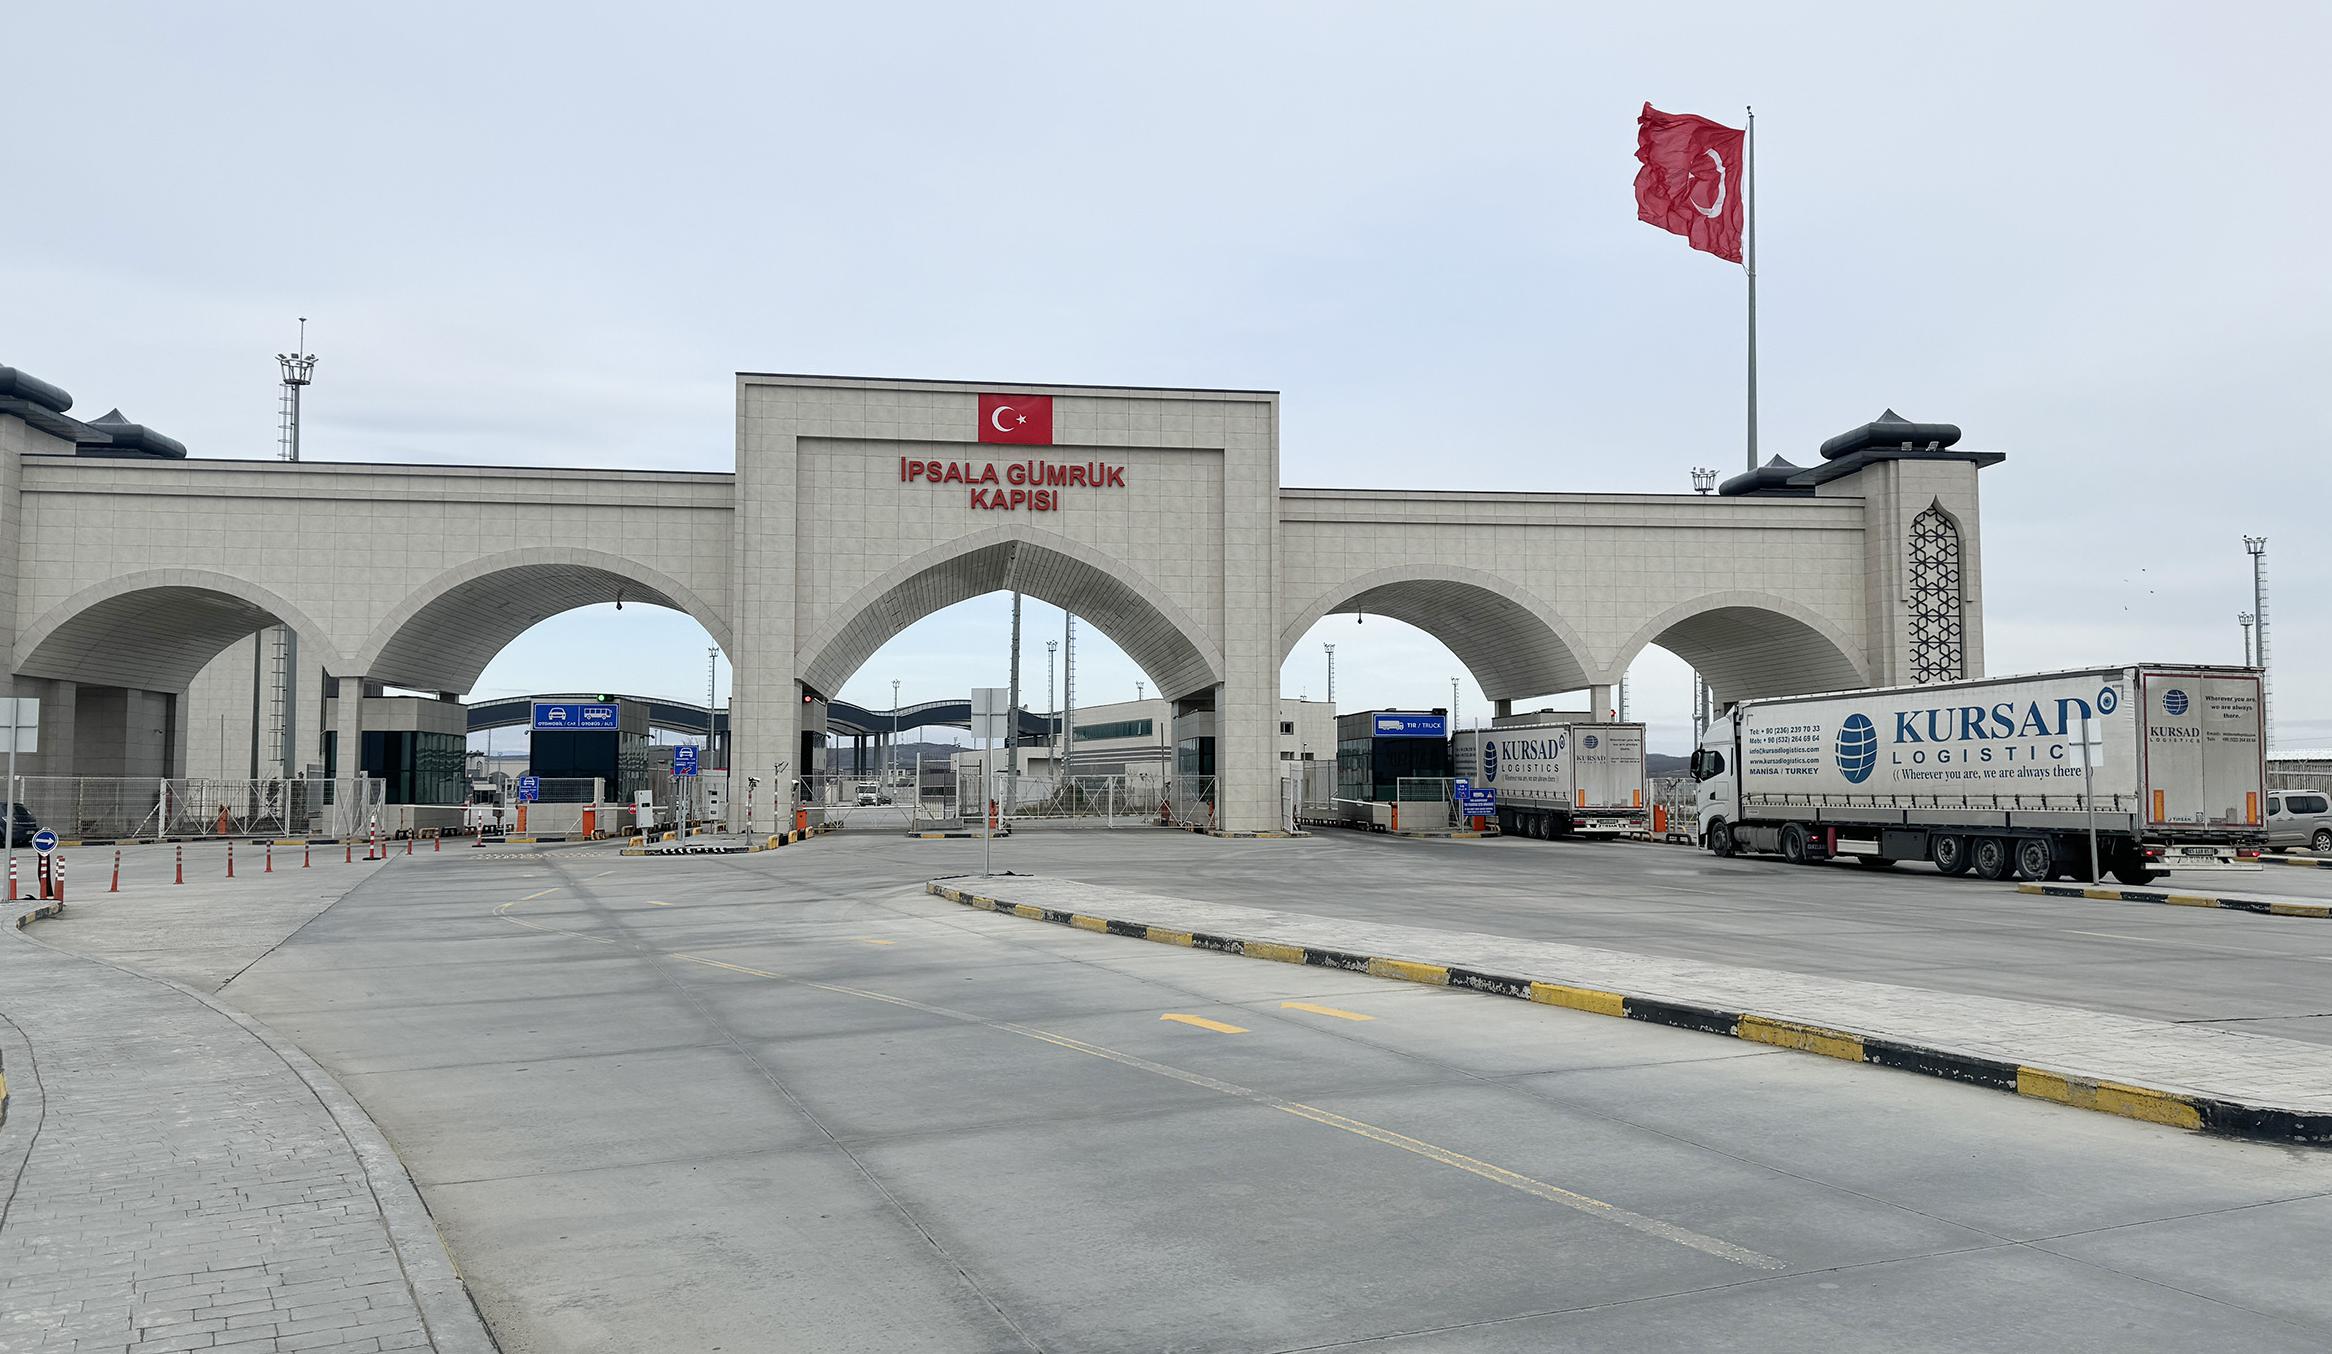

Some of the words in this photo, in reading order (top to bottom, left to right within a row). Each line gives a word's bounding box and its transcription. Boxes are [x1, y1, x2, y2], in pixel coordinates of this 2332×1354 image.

[901, 456, 1000, 484] İPSALA
[1007, 460, 1126, 488] GÜMRÜK
[971, 488, 1058, 511] KAPISI
[1893, 697, 2092, 744] KURSAD
[2150, 726, 2200, 737] KURSAD
[1502, 739, 1559, 761] KURSAD
[1892, 744, 2065, 765] LOGISTIC
[1501, 763, 1559, 773] LOGISTICS
[1785, 767, 1819, 775] TURKEY
[1902, 768, 1943, 781] Wherever
[1945, 770, 1961, 783] you
[1963, 770, 1981, 781] are,
[1984, 769, 1998, 779] we
[1999, 769, 2015, 778] are
[2017, 766, 2050, 781] always
[2053, 764, 2082, 777] there
